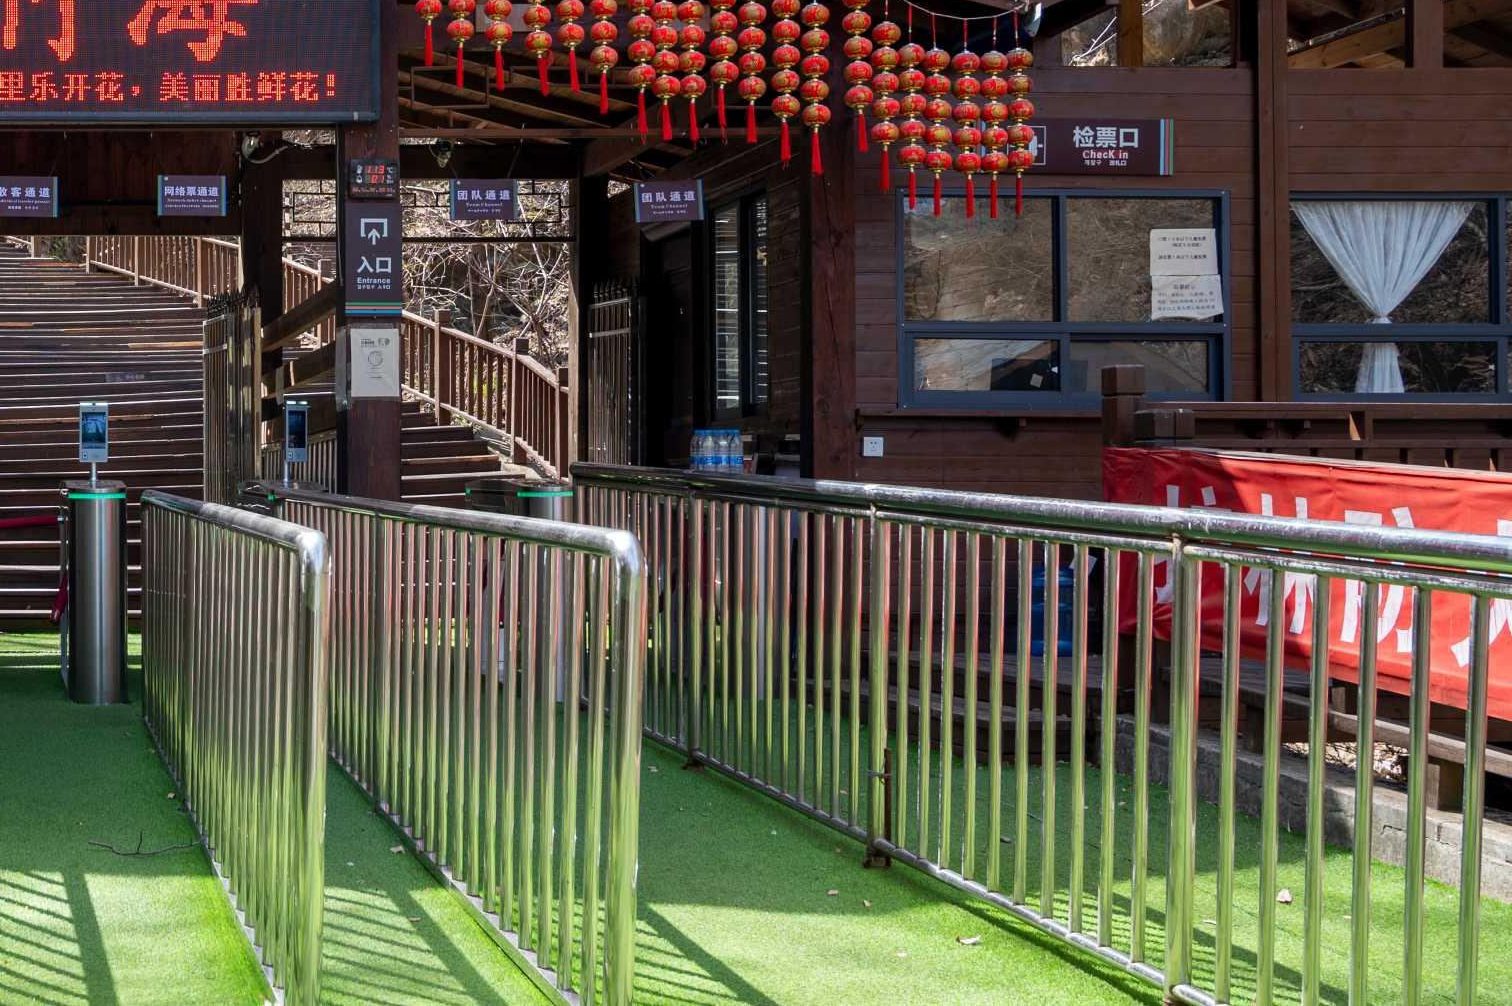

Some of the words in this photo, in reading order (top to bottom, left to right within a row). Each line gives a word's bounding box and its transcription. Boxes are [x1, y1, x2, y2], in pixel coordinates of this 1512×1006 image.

[1073, 126, 1139, 148] 检票口
[164, 185, 220, 197] 网络票通道
[457, 189, 511, 201] 团队通道
[641, 190, 697, 203] 团队通道
[356, 256, 392, 274] 入口
[356, 276, 392, 285] Entrance
